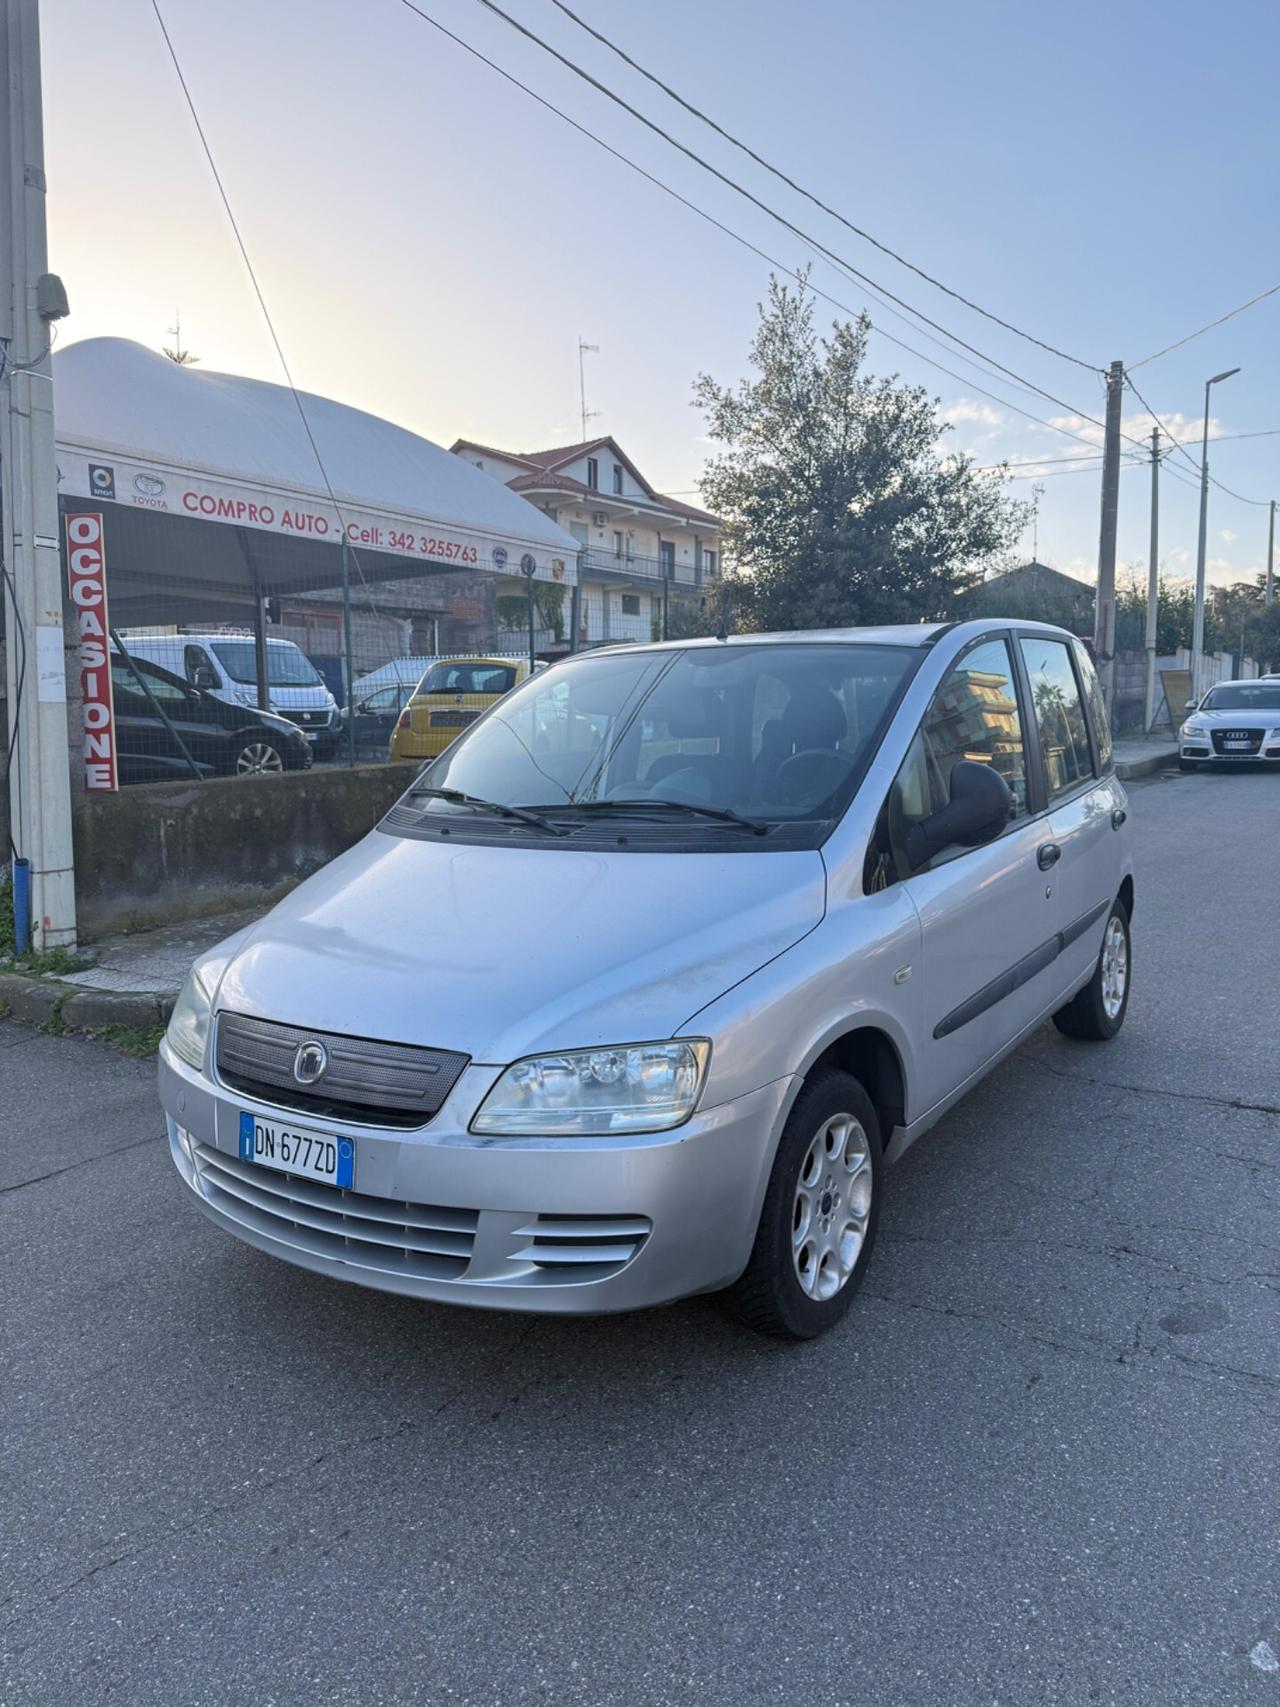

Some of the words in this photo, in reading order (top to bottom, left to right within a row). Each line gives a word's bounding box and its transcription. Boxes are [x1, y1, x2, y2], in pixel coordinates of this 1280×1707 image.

[93, 488, 113, 497] smart
[132, 495, 168, 510] TOYOTA
[182, 492, 275, 525] COMPRO
[281, 510, 329, 535] AUTO
[346, 523, 384, 545] Cell:
[388, 530, 415, 551] 342
[420, 536, 478, 563] 3255763
[68, 516, 112, 789] OCCASIONE
[255, 1125, 275, 1159] DN
[281, 1132, 336, 1174] 677ZD
